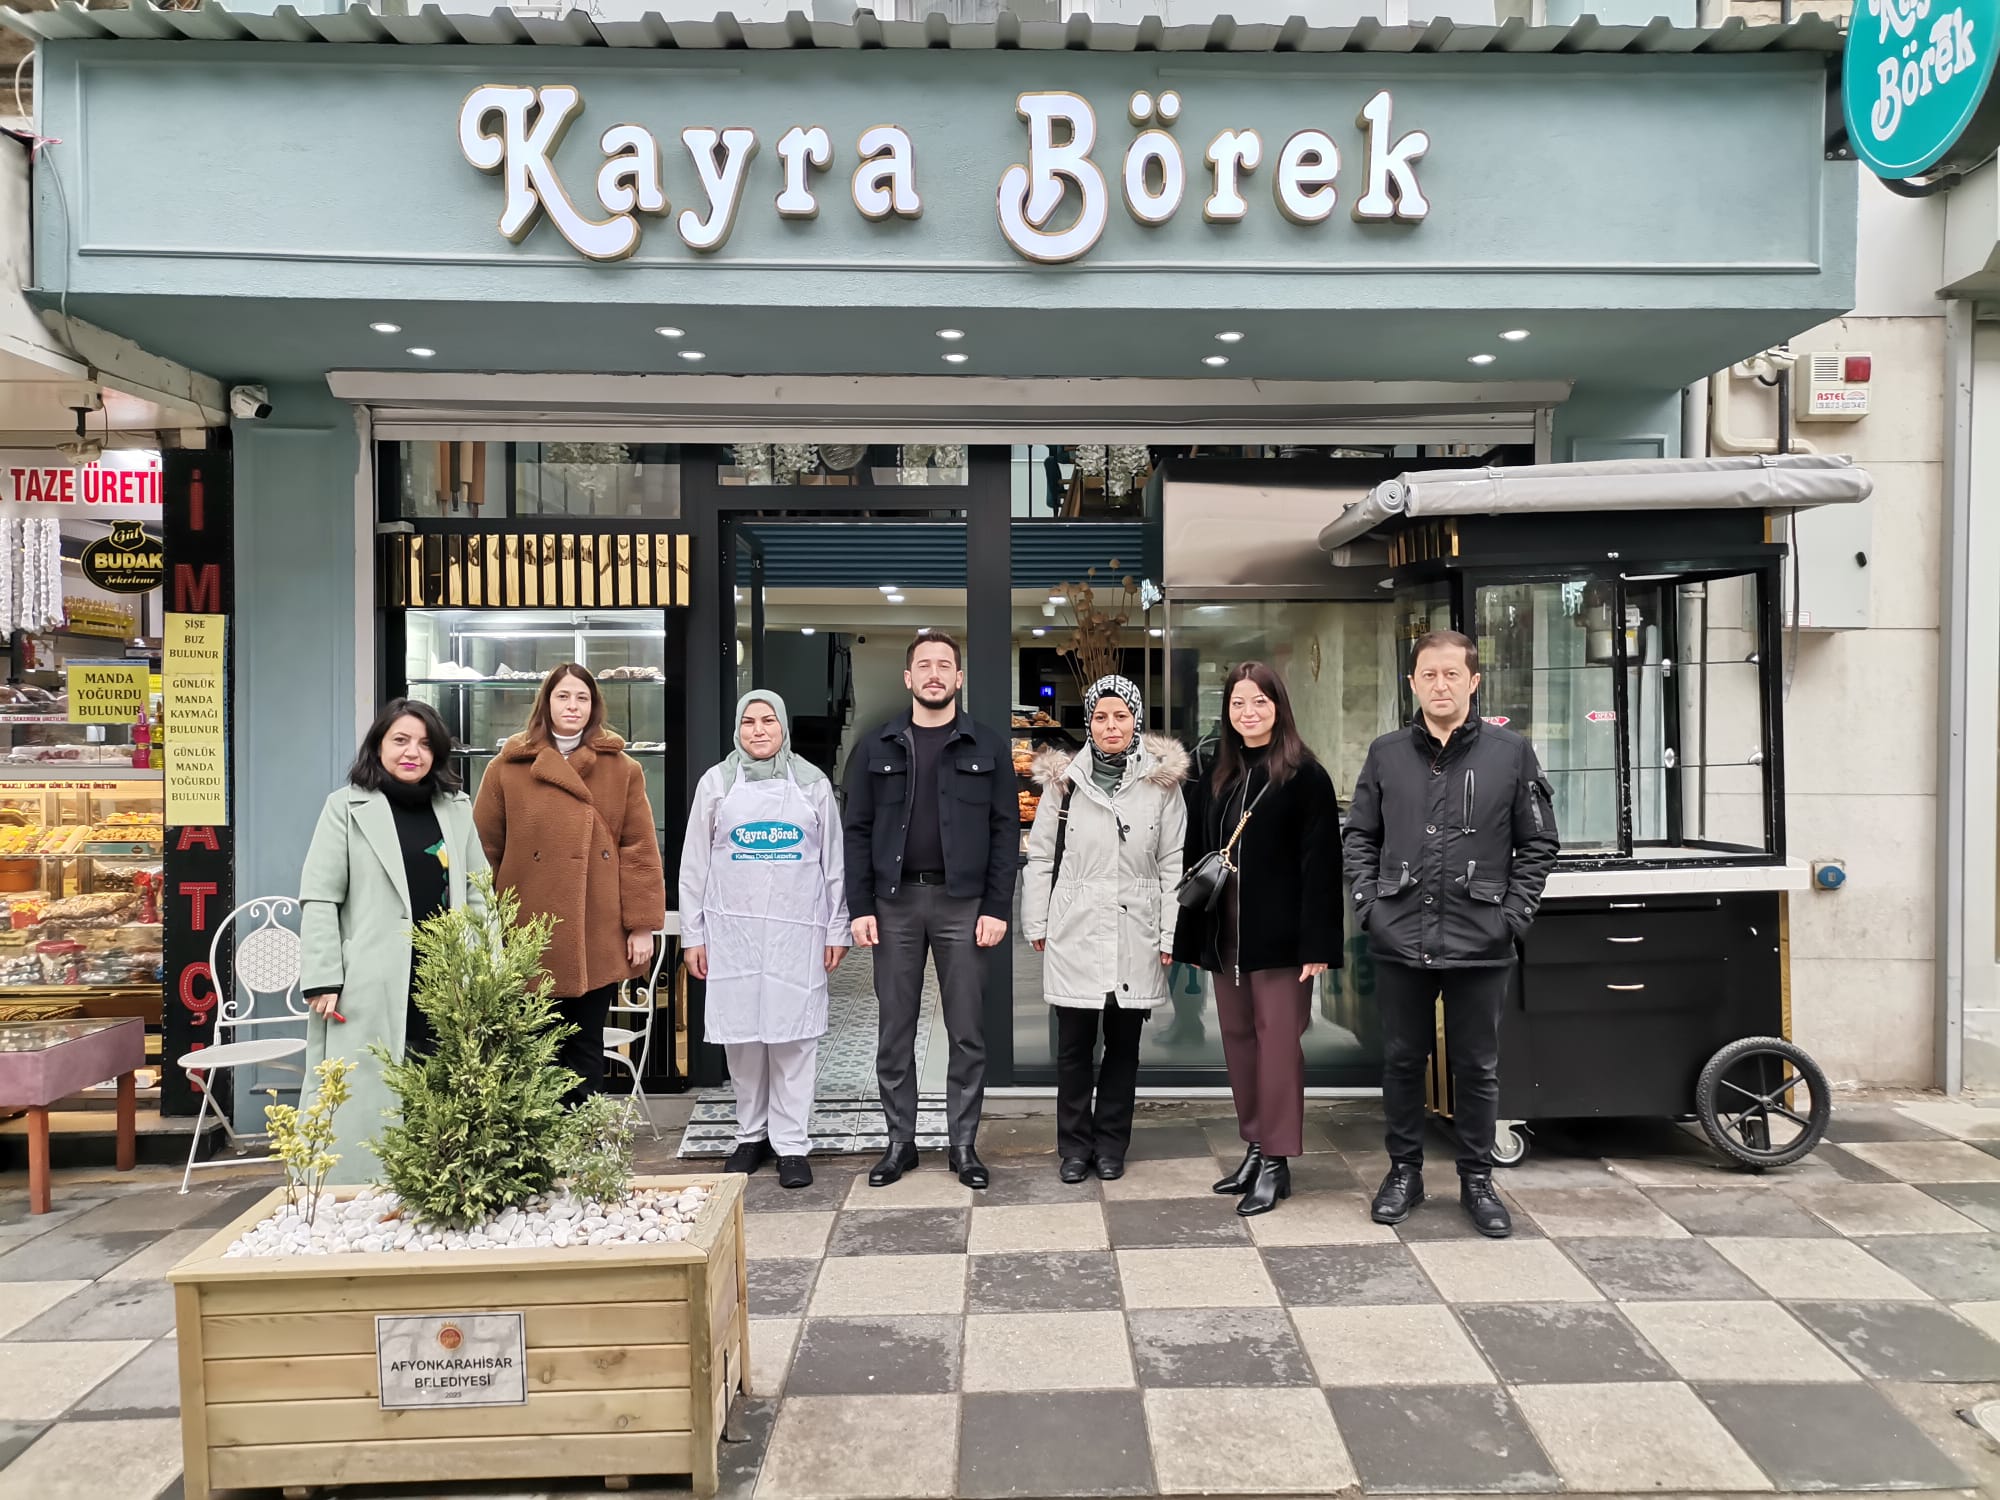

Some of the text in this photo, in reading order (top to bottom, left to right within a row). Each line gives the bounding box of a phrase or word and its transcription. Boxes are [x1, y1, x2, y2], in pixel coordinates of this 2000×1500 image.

[1871, 6, 1976, 141] Börek
[458, 84, 1430, 262] Kayra Börek
[11, 469, 74, 502] TAZE
[113, 528, 139, 543] Gül
[95, 553, 163, 569] BUDAK
[185, 620, 205, 629] ŞİŞE
[184, 635, 205, 644] BUZ
[169, 649, 219, 659] BULUNUR
[85, 673, 134, 684] MANDA
[173, 678, 215, 689] GÜNLÜK
[77, 687, 142, 701] YOĞURDU
[175, 695, 213, 704] MANDA
[79, 704, 140, 716] BULUNUR
[170, 708, 218, 719] KAYMAĞI
[170, 725, 219, 734] BULUNUR
[173, 747, 216, 757] GÜNLÜK
[176, 763, 214, 771] MANDA
[170, 775, 220, 786] YOĞURDU
[171, 793, 220, 801] BULUNUR
[736, 827, 799, 844] Kayra Börek
[391, 1355, 513, 1372] AFYONKARAHİSAR
[415, 1373, 491, 1389] BELEDİYESİ
